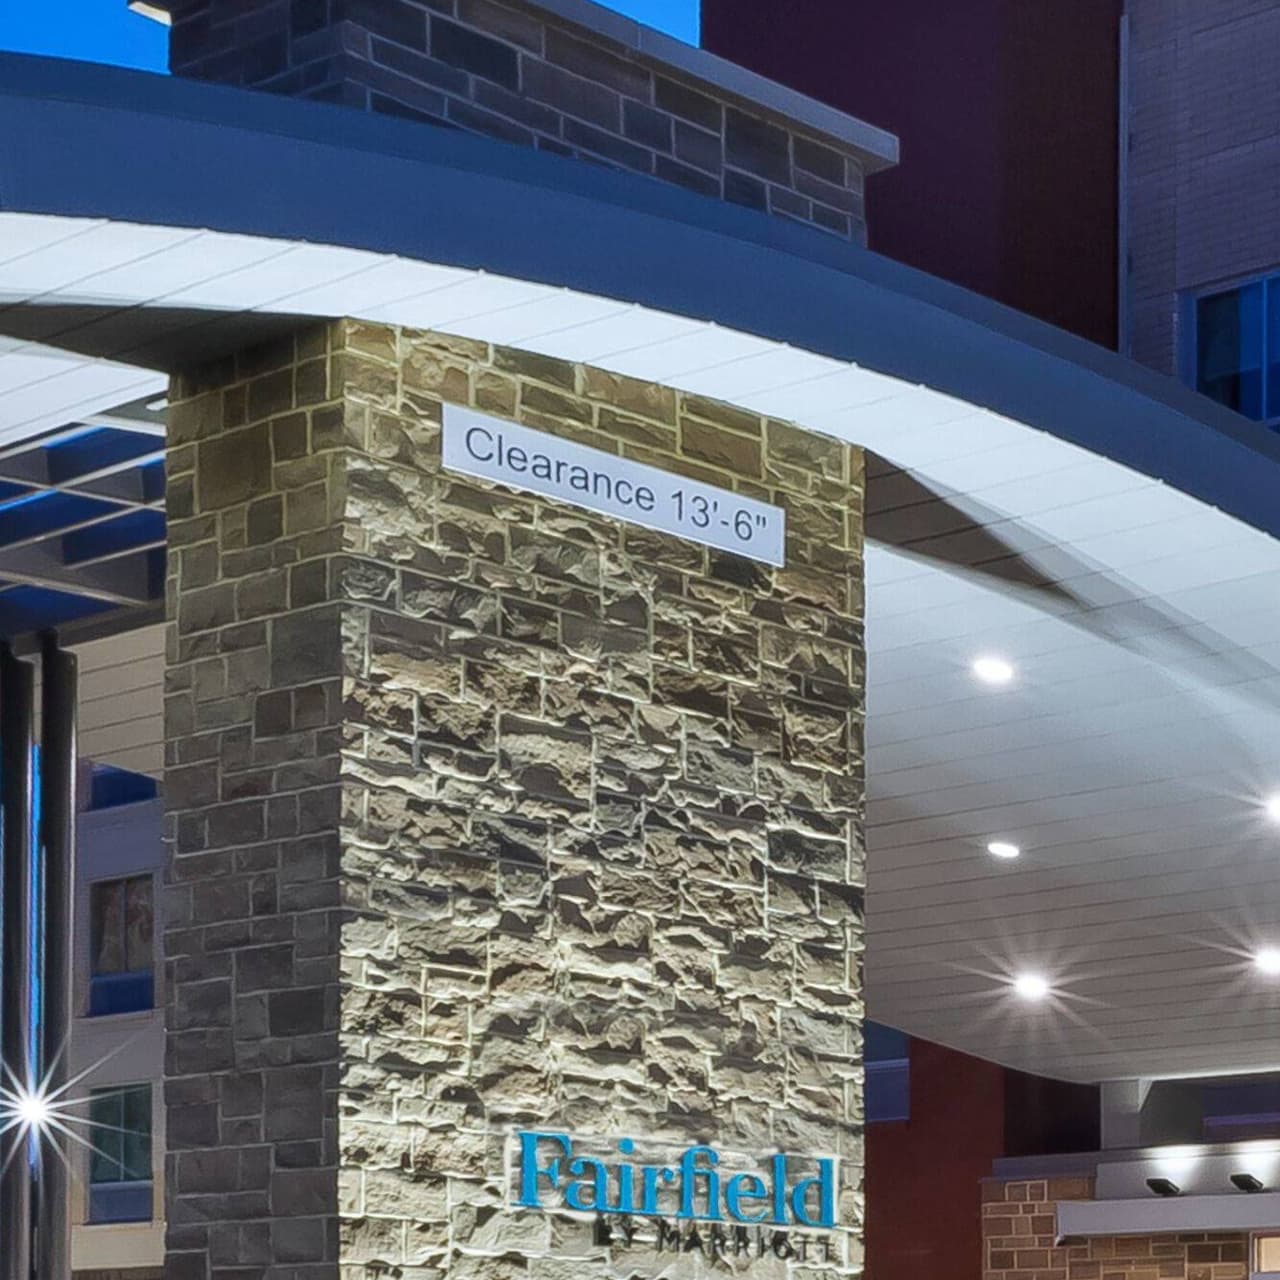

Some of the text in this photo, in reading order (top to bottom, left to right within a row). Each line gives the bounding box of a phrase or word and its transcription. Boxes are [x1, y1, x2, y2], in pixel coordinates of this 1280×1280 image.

[465, 426, 767, 543] Clearance 13'-6"
[510, 1130, 837, 1229] Fairfield
[656, 1216, 834, 1263] MARRIOTT
